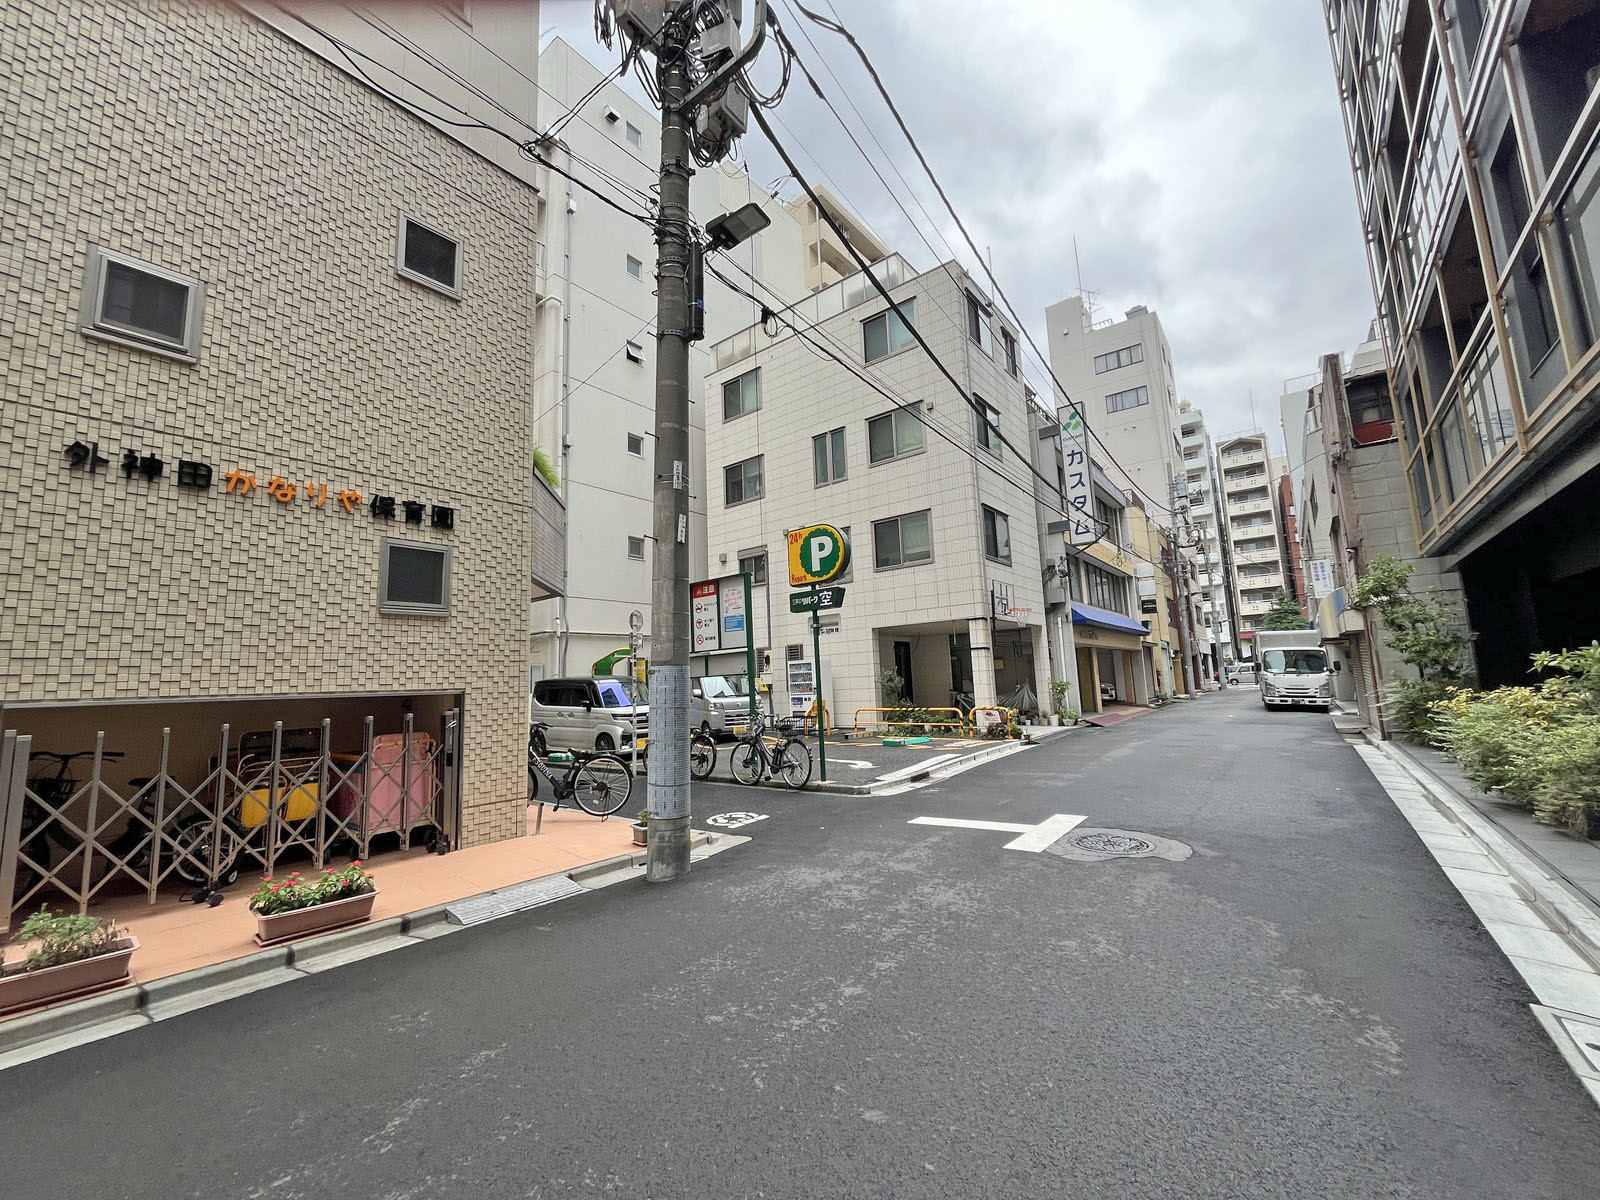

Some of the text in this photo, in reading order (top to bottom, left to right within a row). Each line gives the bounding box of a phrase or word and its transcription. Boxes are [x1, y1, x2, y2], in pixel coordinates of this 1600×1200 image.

[64, 440, 455, 530] 外神田かなりや保育園
[1067, 449, 1091, 536] カスタム
[789, 532, 803, 545] 24h
[810, 535, 833, 572] P
[819, 590, 833, 606] 空
[532, 756, 553, 780] ESQUINA
